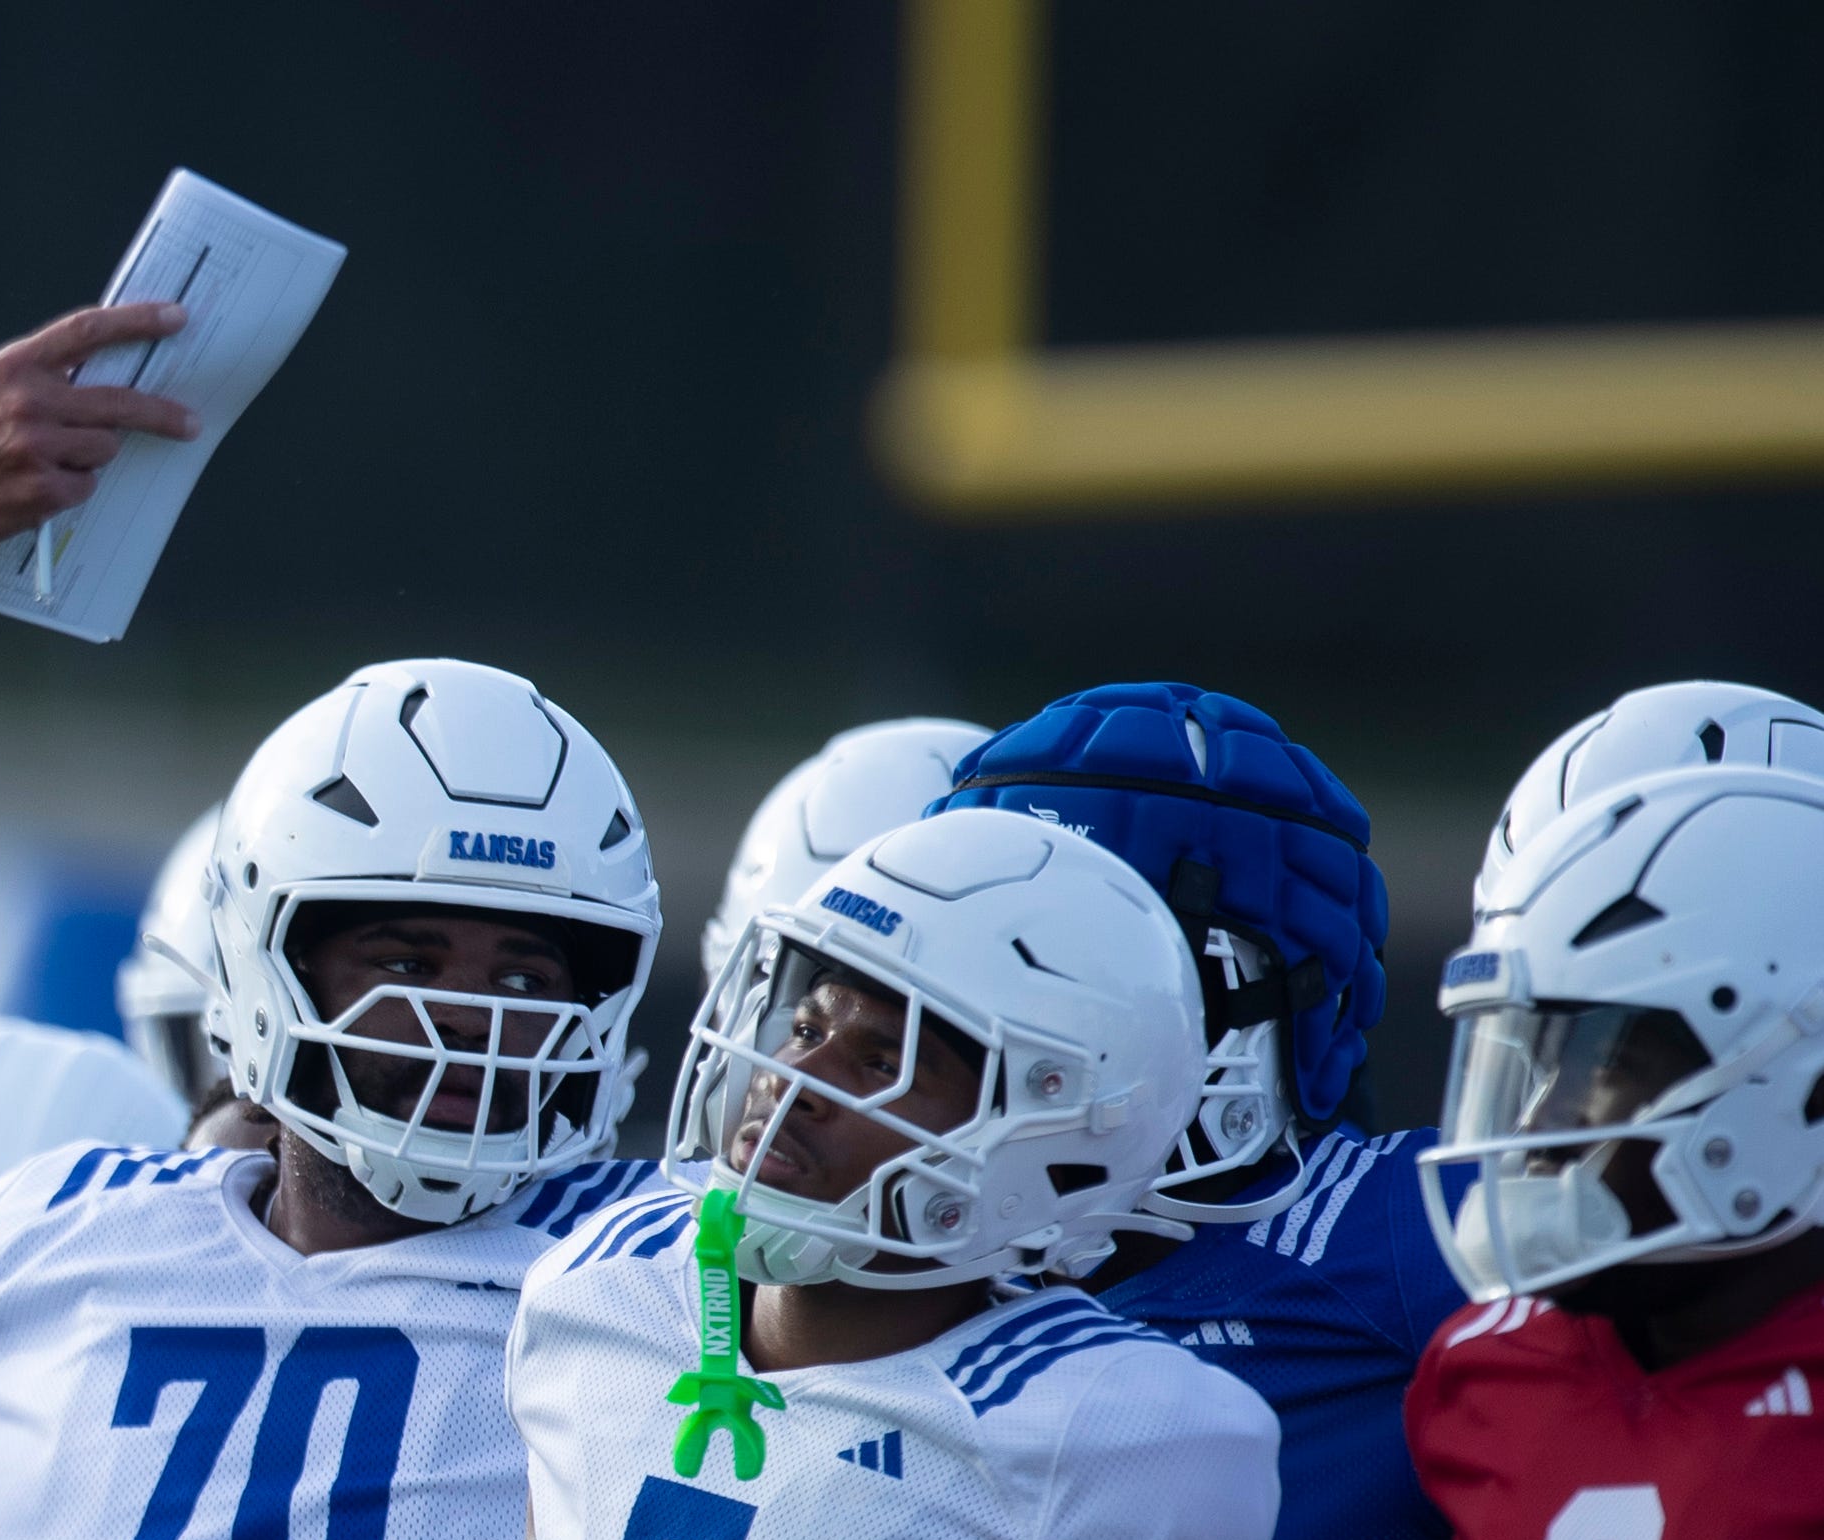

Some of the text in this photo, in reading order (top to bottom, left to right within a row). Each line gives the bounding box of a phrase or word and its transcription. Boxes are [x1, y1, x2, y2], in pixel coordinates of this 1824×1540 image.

[449, 829, 556, 870] KANSAS
[819, 886, 904, 937] KANSAS
[704, 1268, 732, 1356] NXTRND
